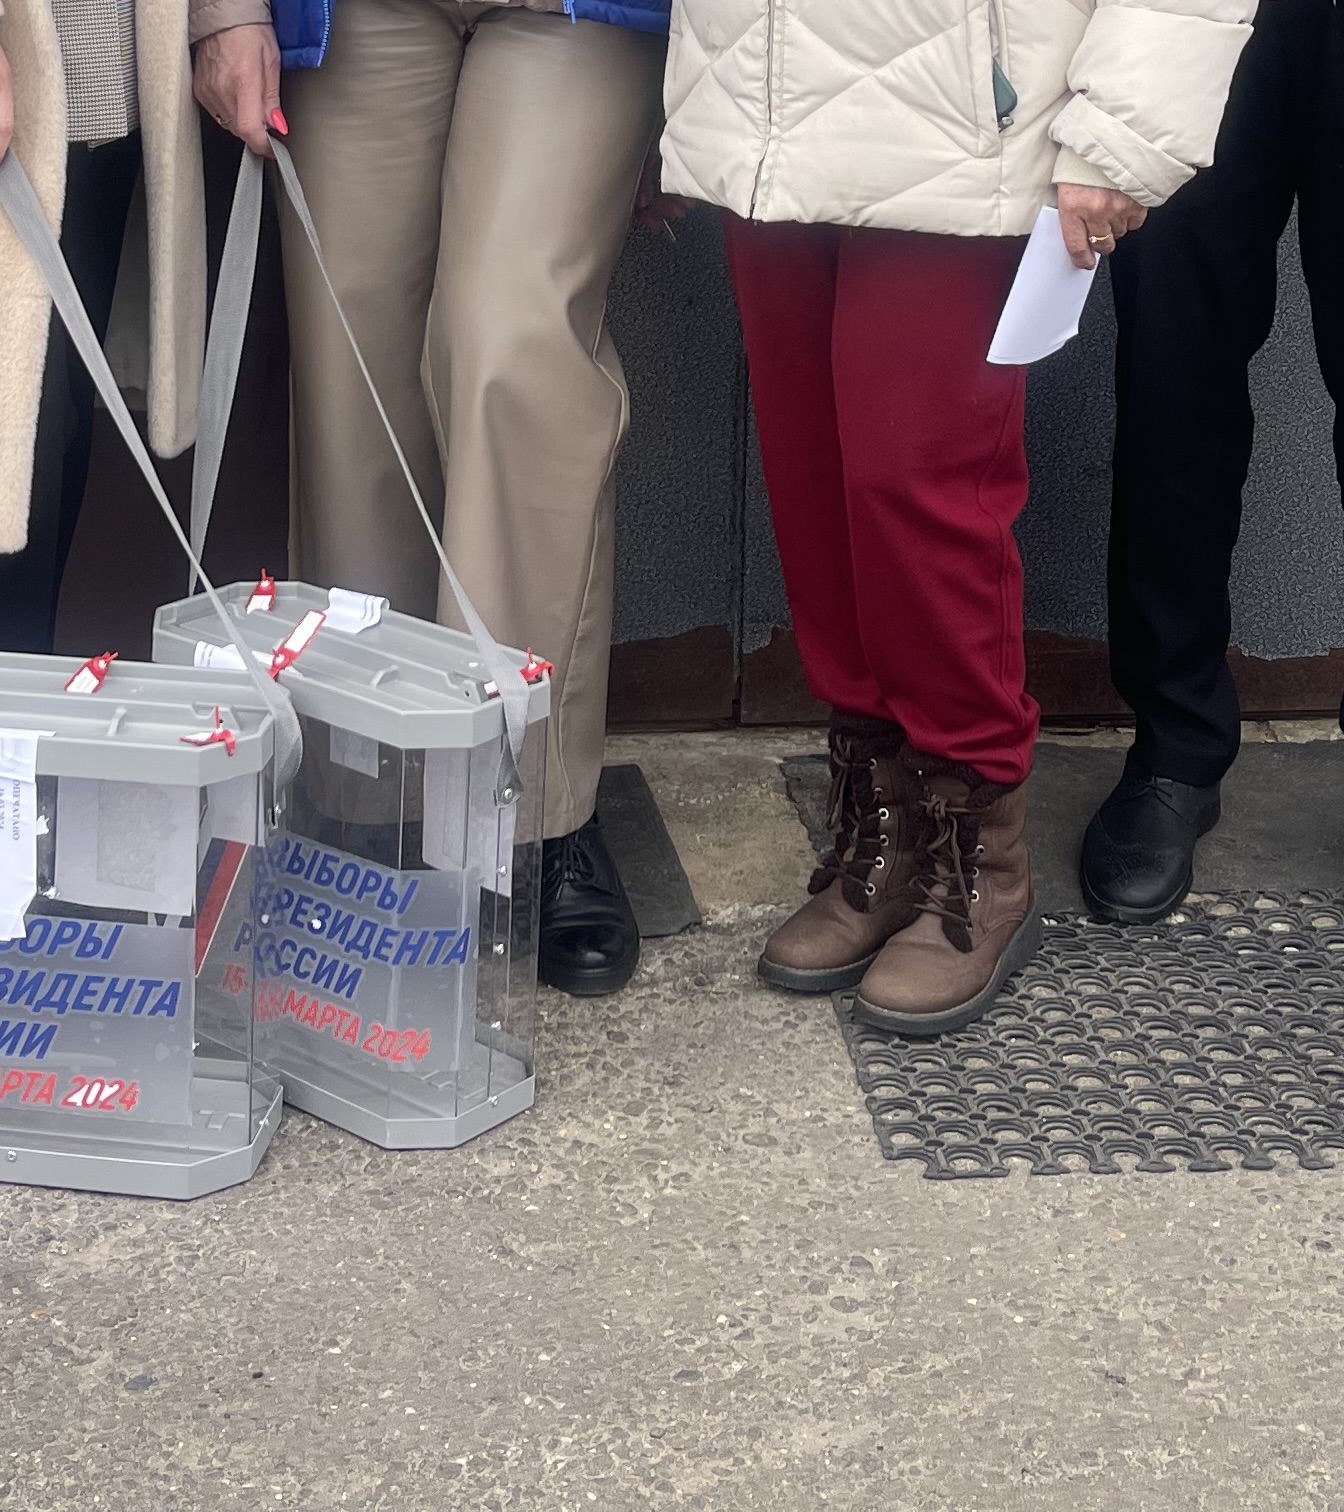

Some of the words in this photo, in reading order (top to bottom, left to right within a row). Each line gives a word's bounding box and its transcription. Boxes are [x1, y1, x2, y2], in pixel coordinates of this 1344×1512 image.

[282, 988, 362, 1045] МАРТА
[362, 1023, 432, 1063] 2024
[60, 1075, 141, 1113] 2024
